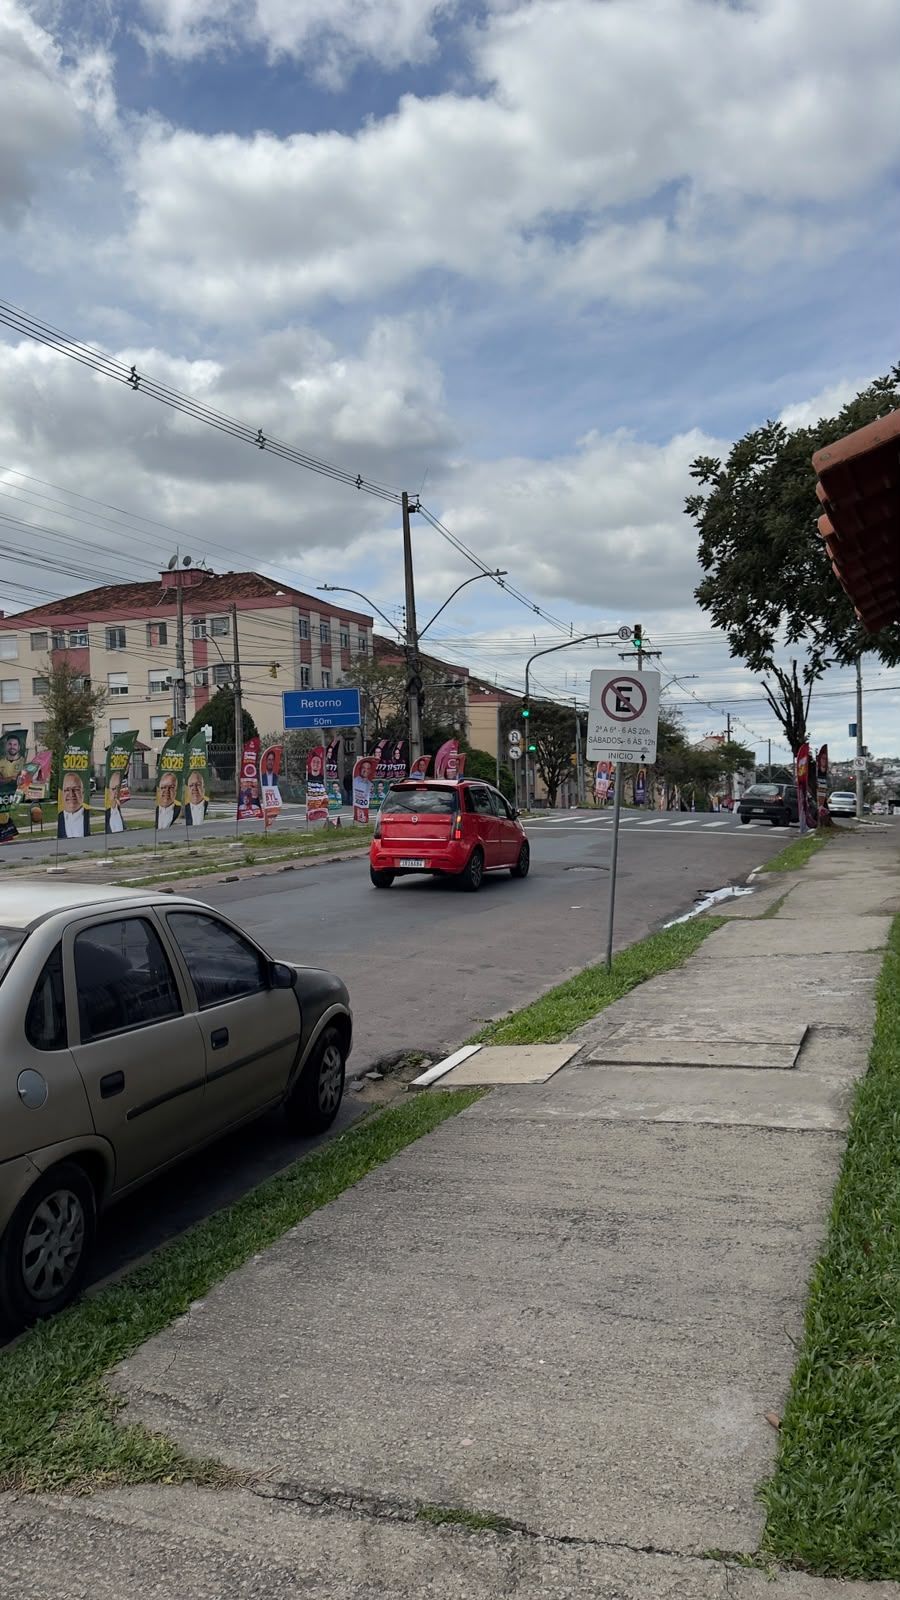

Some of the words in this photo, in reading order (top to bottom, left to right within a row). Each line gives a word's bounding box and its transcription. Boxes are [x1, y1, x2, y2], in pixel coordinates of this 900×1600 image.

[300, 699, 342, 709] Retorno
[313, 717, 332, 726] 50m
[621, 726, 626, 734] 6
[638, 727, 651, 735] 20h
[626, 737, 632, 745] 6
[644, 738, 656, 746] 12h
[63, 755, 89, 768] 3026
[161, 756, 184, 769] 3026
